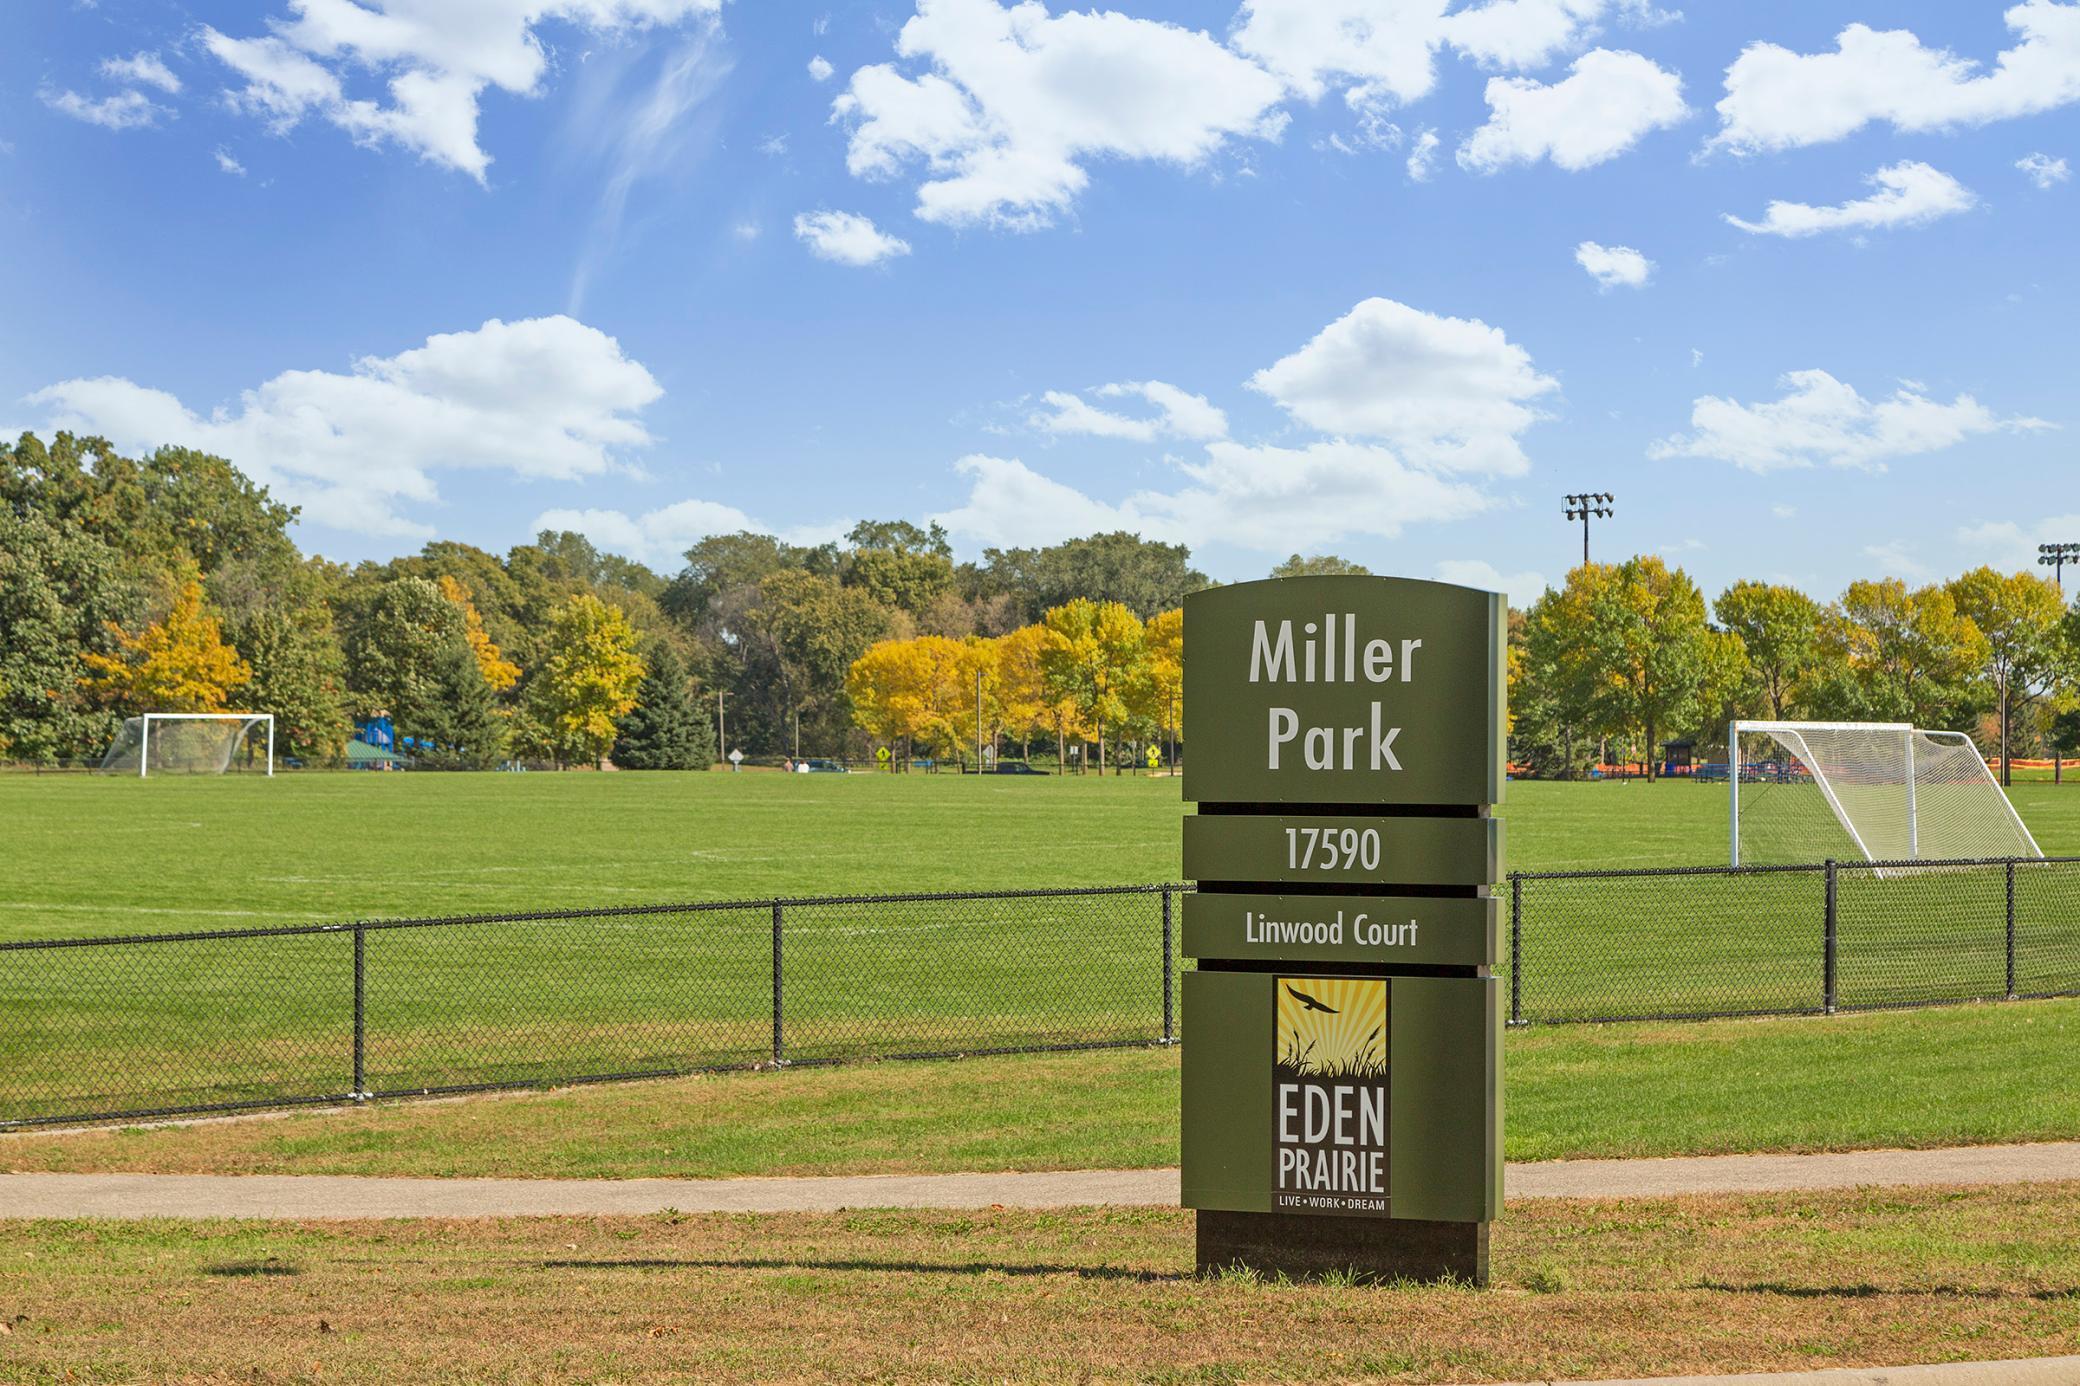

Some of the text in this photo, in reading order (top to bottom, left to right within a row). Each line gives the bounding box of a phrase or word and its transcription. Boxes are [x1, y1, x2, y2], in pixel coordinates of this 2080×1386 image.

[1249, 613, 1422, 682] Miller
[1268, 702, 1403, 771] Park
[1285, 828, 1381, 871] 17590
[1246, 911, 1418, 946] Linwood Court
[1279, 1083, 1385, 1147] EDEN
[1279, 1148, 1385, 1193] PRAIRIE
